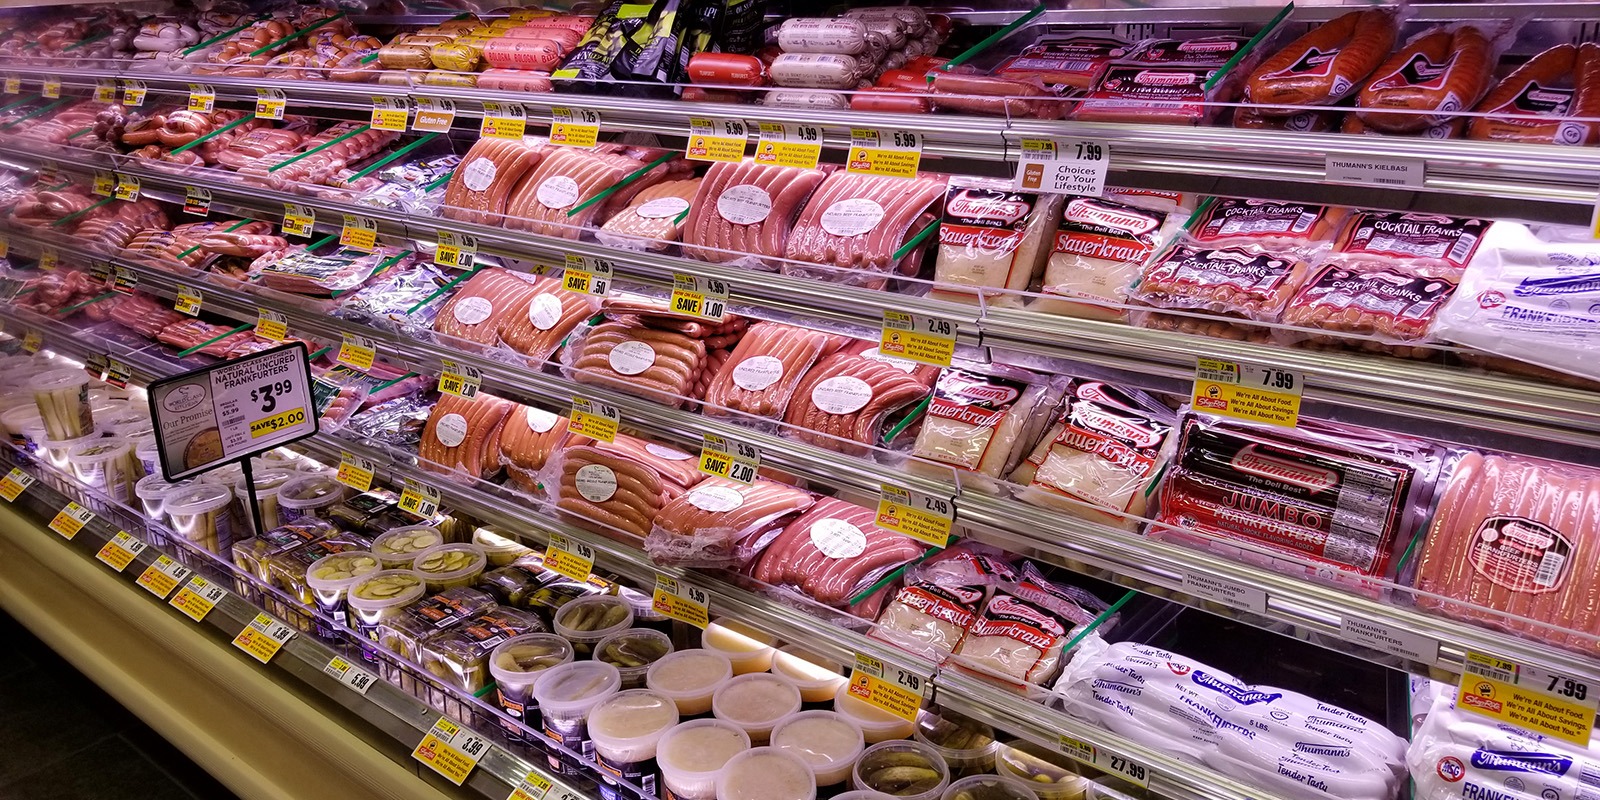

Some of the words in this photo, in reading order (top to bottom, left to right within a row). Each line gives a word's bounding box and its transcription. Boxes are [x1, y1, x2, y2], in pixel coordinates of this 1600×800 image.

[489, 53, 510, 61] BOLOGNA
[514, 54, 537, 62] BOLOGNA
[420, 116, 434, 124] Gluten
[435, 117, 447, 125] Free
[581, 108, 597, 123] 1.25
[725, 122, 743, 135] 5.99
[799, 127, 816, 140] 4.99
[894, 132, 916, 148] 5.99
[1075, 144, 1102, 160] 7.99
[1058, 166, 1095, 175] Choices
[1375, 164, 1408, 172] KIELBASI
[1055, 174, 1070, 182] for
[1073, 175, 1096, 183] Your
[1054, 182, 1096, 193] Lifestyle
[1225, 207, 1264, 217] COCKTAIL
[1374, 221, 1420, 234] COCKTAIL
[1423, 225, 1463, 237] FRANKS
[1056, 235, 1148, 265] Sauerkraut
[440, 251, 455, 263] SAVE
[459, 254, 472, 267] 2.00
[595, 259, 609, 273] 3.99
[1183, 259, 1226, 270] COCKTAIL
[1228, 263, 1266, 277] FRANKS
[568, 277, 586, 290] SAVE
[593, 280, 606, 294] .50
[708, 280, 724, 294] 4.99
[677, 297, 697, 312] SAVE
[705, 301, 723, 318] 1.00
[928, 319, 950, 335] 2.49
[215, 367, 255, 384] NATURAL
[256, 355, 295, 370] UNCURED
[217, 365, 240, 375] WORLD
[1220, 364, 1234, 372] 7.99
[225, 364, 288, 390] FRANKFURTERS
[1262, 370, 1293, 389] 7.99
[444, 379, 460, 392] SAVE
[462, 384, 477, 398] 2.00
[1261, 395, 1276, 403] About
[1278, 398, 1292, 406] Food.
[1272, 406, 1295, 414] Savings.
[163, 419, 179, 430] Our
[180, 408, 213, 424] Promise
[250, 421, 270, 432] SAVE
[270, 412, 304, 429] $2.00
[738, 444, 755, 458] 3.99
[705, 458, 726, 474] SAVE
[731, 464, 754, 482] 2.00
[1238, 454, 1327, 487] Thumann's
[1265, 479, 1280, 487] Deli
[403, 497, 417, 509] SAVE
[420, 502, 435, 516] 1.00
[925, 497, 947, 514] 2.49
[1223, 491, 1322, 529] JUMBO
[1186, 573, 1222, 587] THUMANN'S
[1223, 583, 1246, 595] JUMBO
[1187, 580, 1236, 597] FRANKFURTERS
[689, 588, 705, 603] 4.99
[1346, 620, 1388, 635] THUMANN'S
[1346, 626, 1403, 646] FRANKFURTERS
[1495, 661, 1512, 670] 7.99
[351, 674, 369, 689] 5.99
[898, 670, 919, 690] 2.49
[1548, 675, 1587, 700] 7.99
[1092, 690, 1116, 707] Tender
[1513, 693, 1532, 704] We're
[1544, 703, 1564, 714] About
[1566, 709, 1584, 720] Food.
[1316, 703, 1345, 716] Tender
[1346, 712, 1367, 725] Tasty
[1506, 702, 1524, 711] We're
[1537, 710, 1557, 720] About
[1558, 716, 1587, 730] Savings.
[1509, 711, 1527, 722] We're
[1529, 717, 1538, 725] All
[1540, 720, 1560, 731] About
[462, 738, 483, 755] 3.99
[1292, 741, 1353, 757] Thumann's
[1111, 756, 1145, 780] 27.99
[1277, 763, 1306, 782] Tender
[1307, 775, 1328, 792] Tasty
